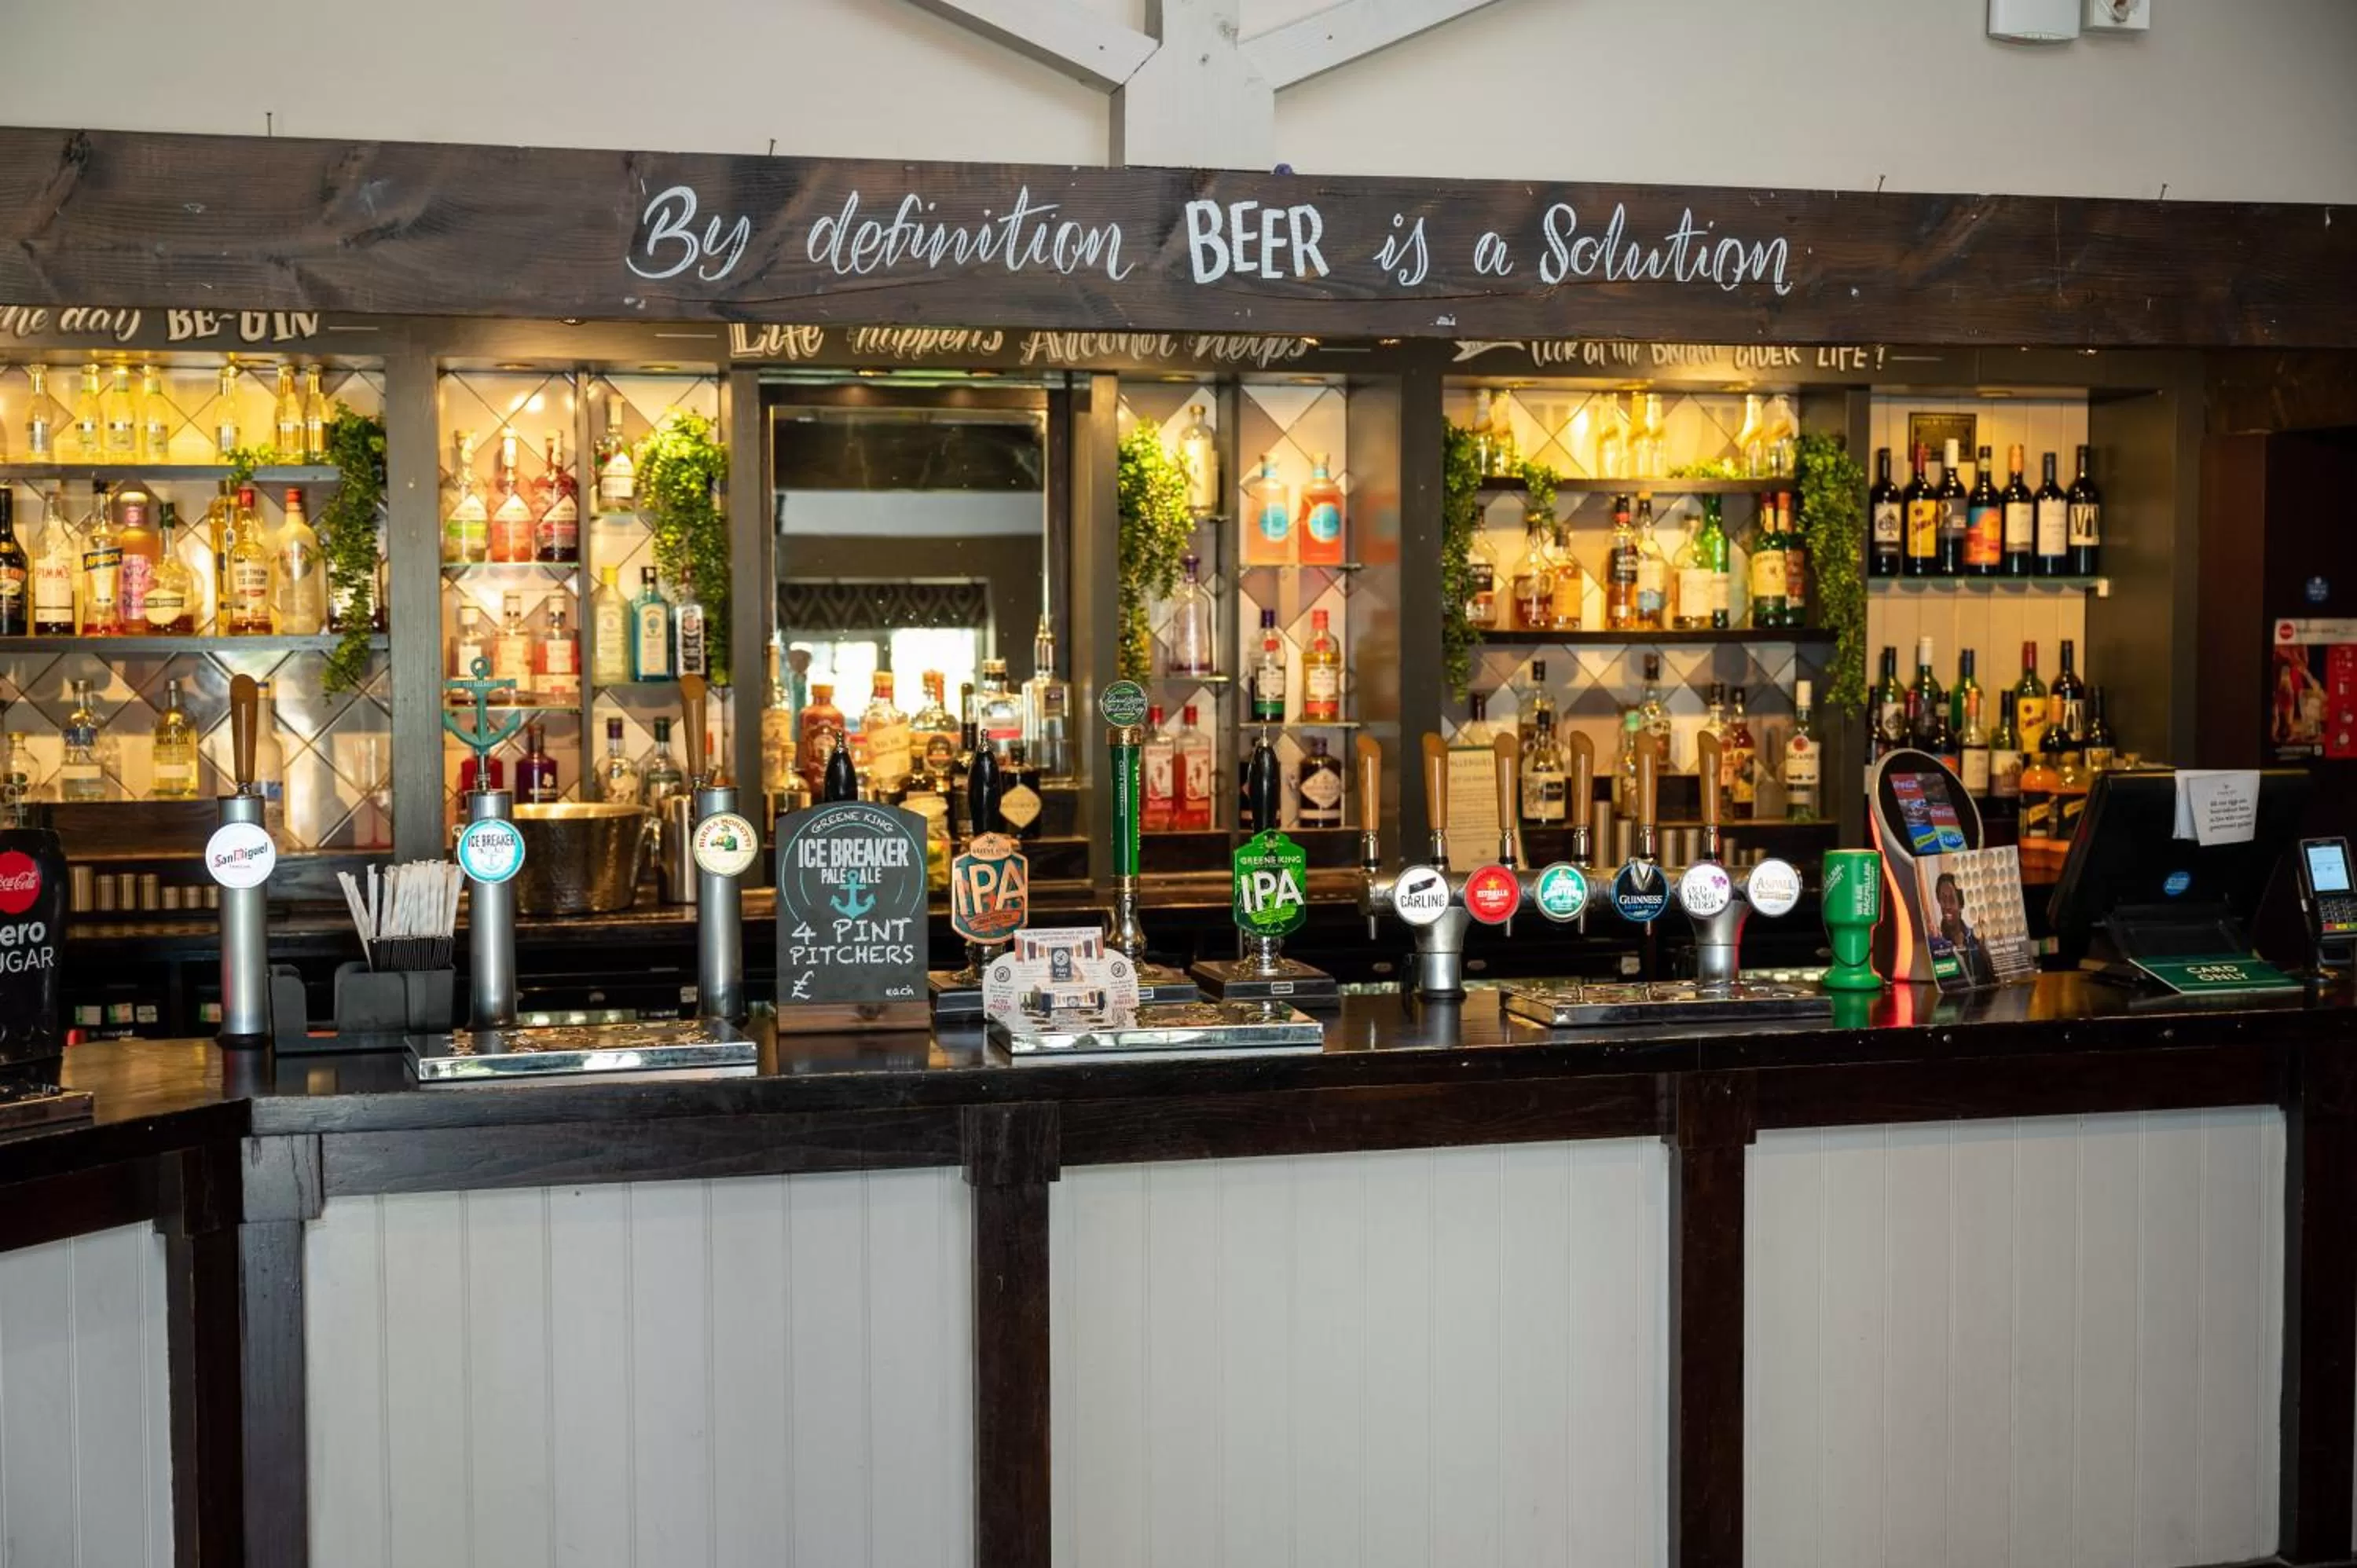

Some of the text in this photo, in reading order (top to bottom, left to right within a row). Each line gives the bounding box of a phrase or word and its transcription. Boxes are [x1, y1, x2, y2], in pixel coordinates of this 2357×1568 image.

[626, 185, 1794, 295] By definition BEER is a Solution
[0, 306, 48, 337] he
[811, 811, 894, 833] GREENE KING
[467, 833, 516, 848] ICE BREAKER
[797, 838, 909, 868] ICE BREAKER
[1240, 855, 1302, 865] GREENE KING
[0, 871, 38, 892] ca-Cola
[821, 868, 882, 885] PALE ALE
[954, 859, 1025, 916] IPA
[1240, 868, 1305, 914] IPA
[1399, 893, 1446, 909] CARLING
[1619, 895, 1663, 905] GUINNESS
[0, 921, 46, 947] ero
[791, 918, 913, 944] 4 PINT
[0, 947, 55, 973] GAR
[790, 944, 914, 965] PITCHERS
[2187, 965, 2238, 974] CARD
[2198, 973, 2249, 981] ONLY
[791, 970, 815, 999] £
[885, 984, 914, 997] each
